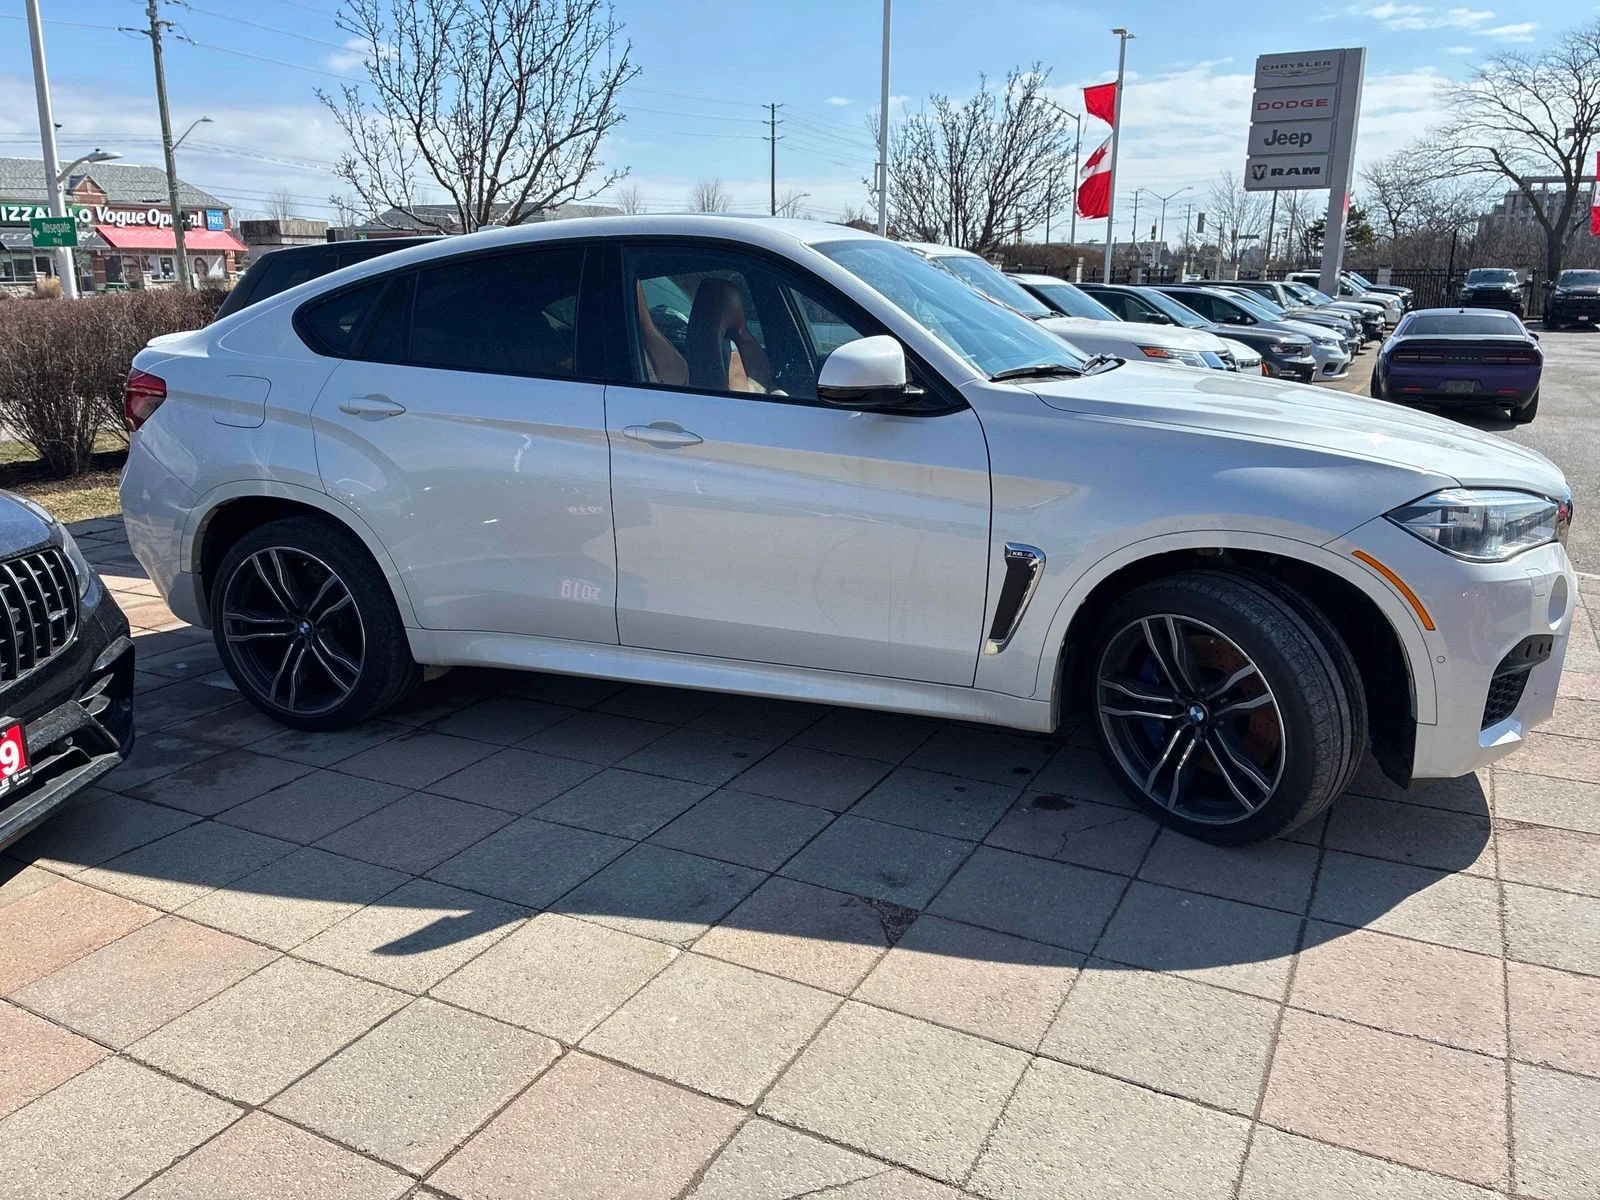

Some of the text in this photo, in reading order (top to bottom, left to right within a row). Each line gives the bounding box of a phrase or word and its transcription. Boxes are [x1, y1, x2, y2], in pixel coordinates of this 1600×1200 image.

[1262, 60, 1331, 71] CHRYSLER
[1257, 98, 1328, 111] DODGE
[1263, 129, 1313, 148] Jeep
[1270, 166, 1321, 176] RAM
[95, 206, 146, 227] Vogue
